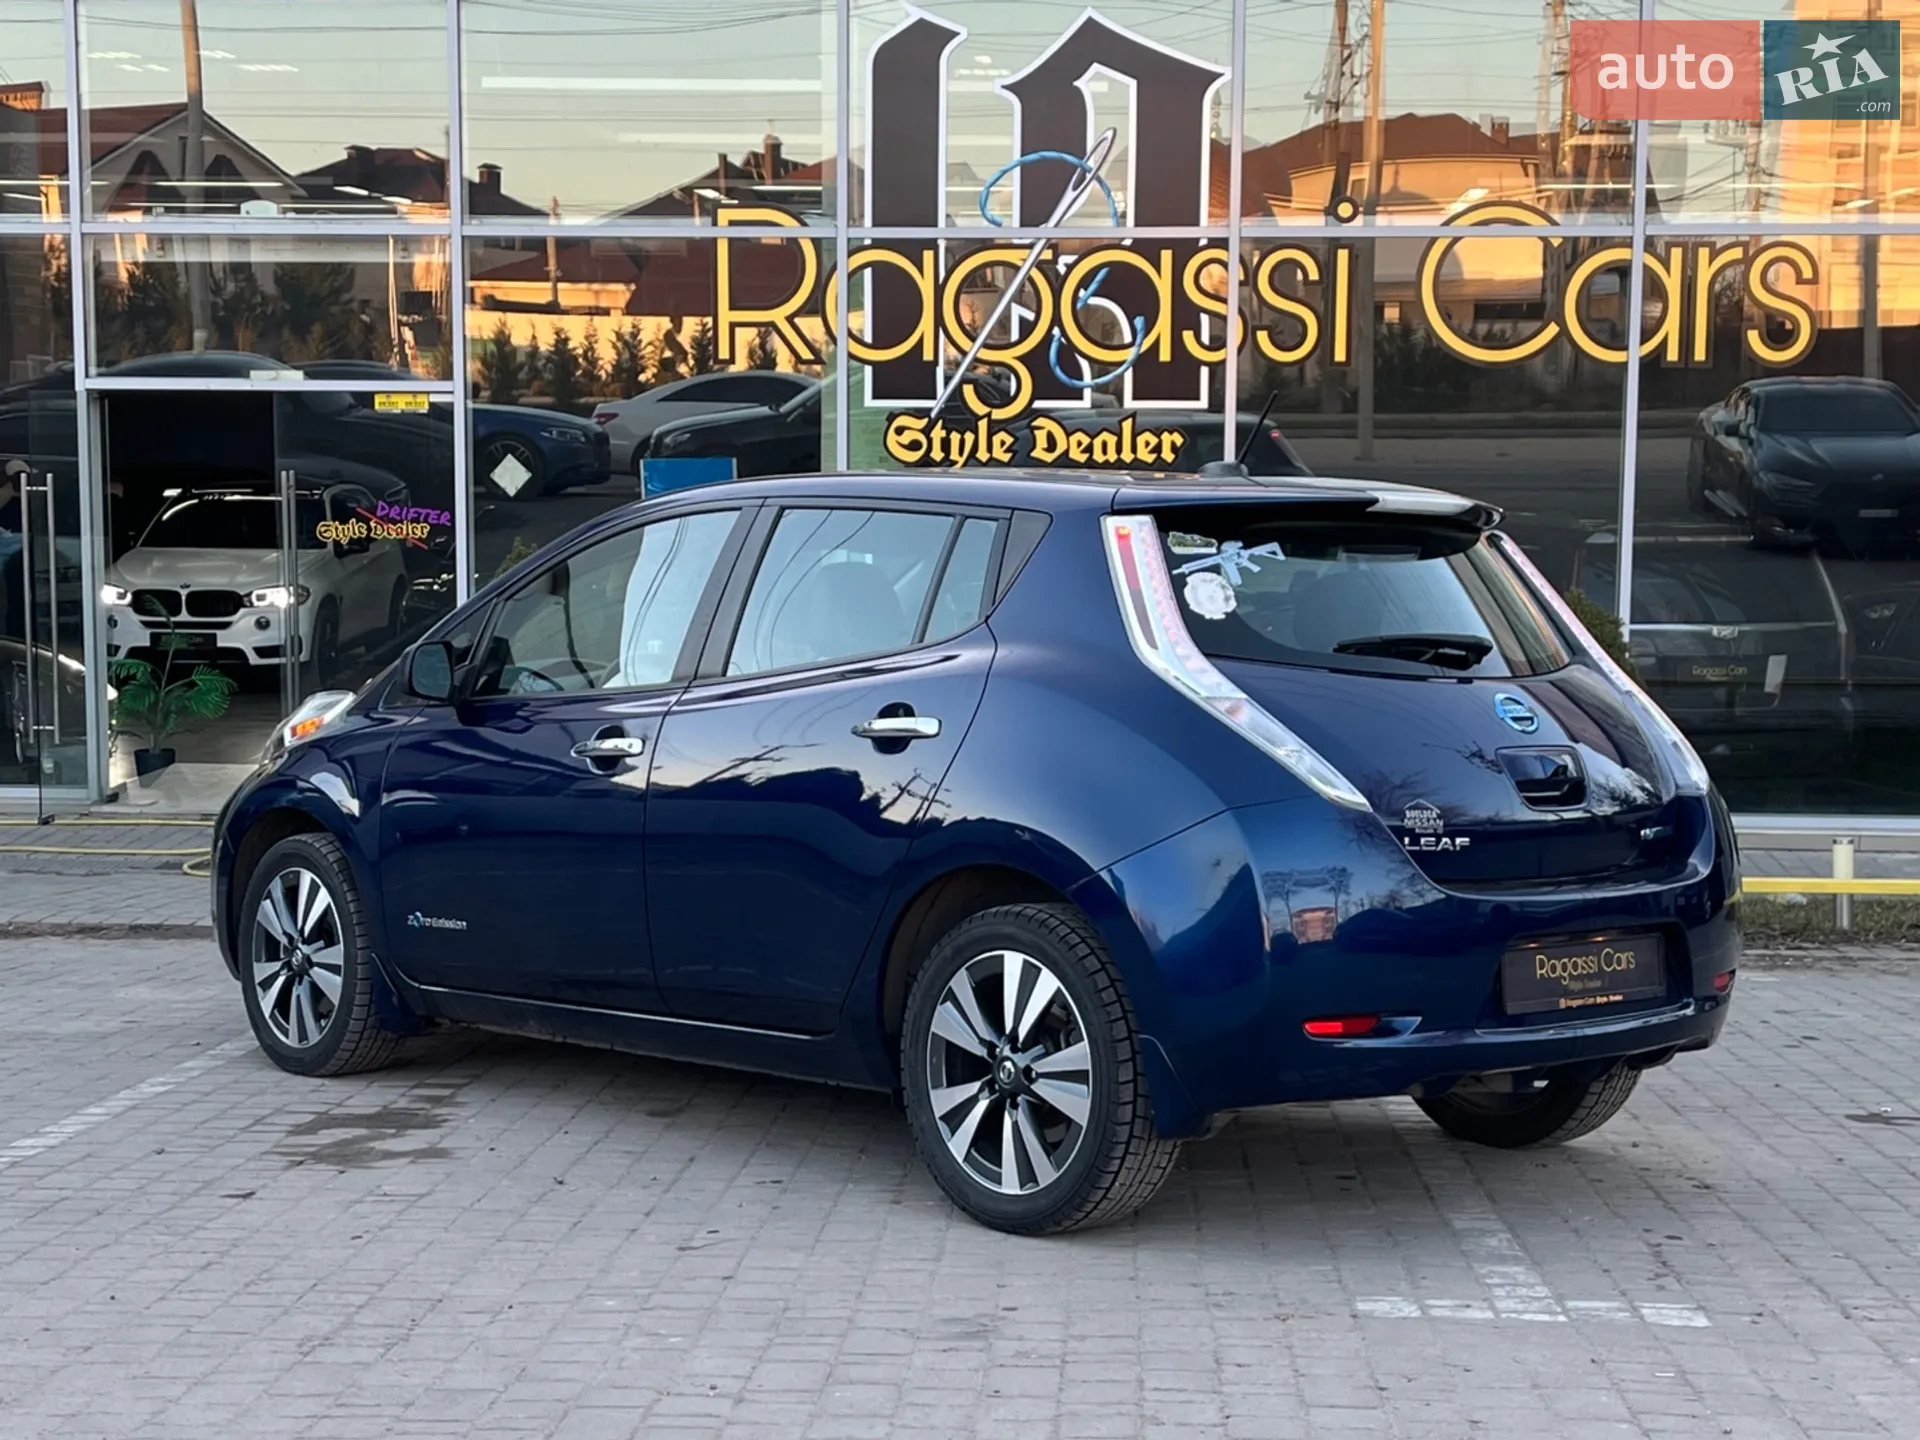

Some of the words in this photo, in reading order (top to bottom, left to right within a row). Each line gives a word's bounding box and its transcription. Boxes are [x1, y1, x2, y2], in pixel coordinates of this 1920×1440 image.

[714, 201, 1355, 419] Ragassi
[1419, 204, 1814, 364] Cars
[884, 410, 1016, 469] Style
[1029, 410, 1186, 465] Dealer
[375, 499, 453, 527] DRIFTER
[316, 517, 368, 546] Style
[369, 516, 431, 540] Dealer
[1403, 836, 1471, 852] LEAF
[1535, 950, 1599, 986] Ragassi
[1600, 947, 1637, 972] Cars
